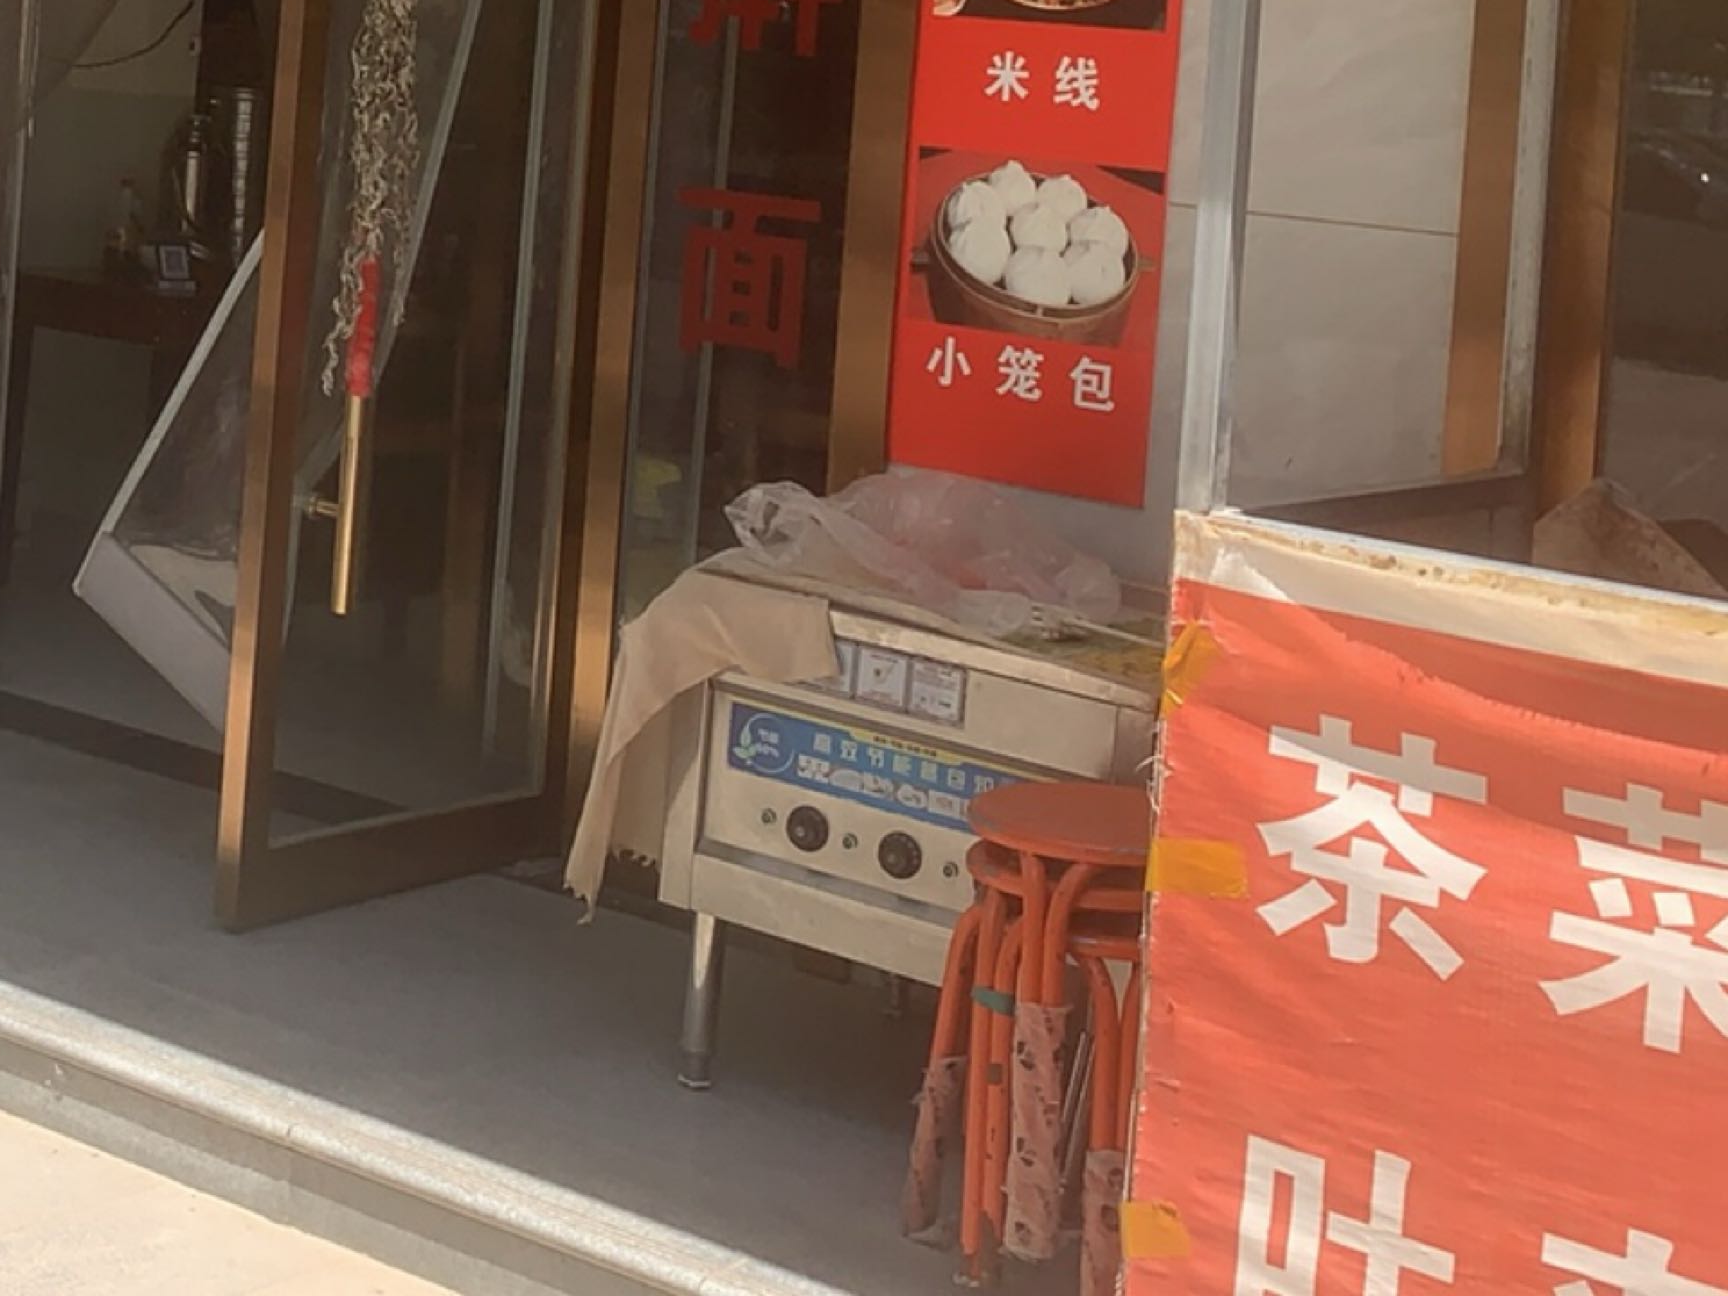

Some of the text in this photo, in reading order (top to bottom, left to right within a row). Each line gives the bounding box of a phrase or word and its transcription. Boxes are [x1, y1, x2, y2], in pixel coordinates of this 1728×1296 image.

[985, 51, 1100, 110] 米线
[927, 337, 1114, 411] 小笼包
